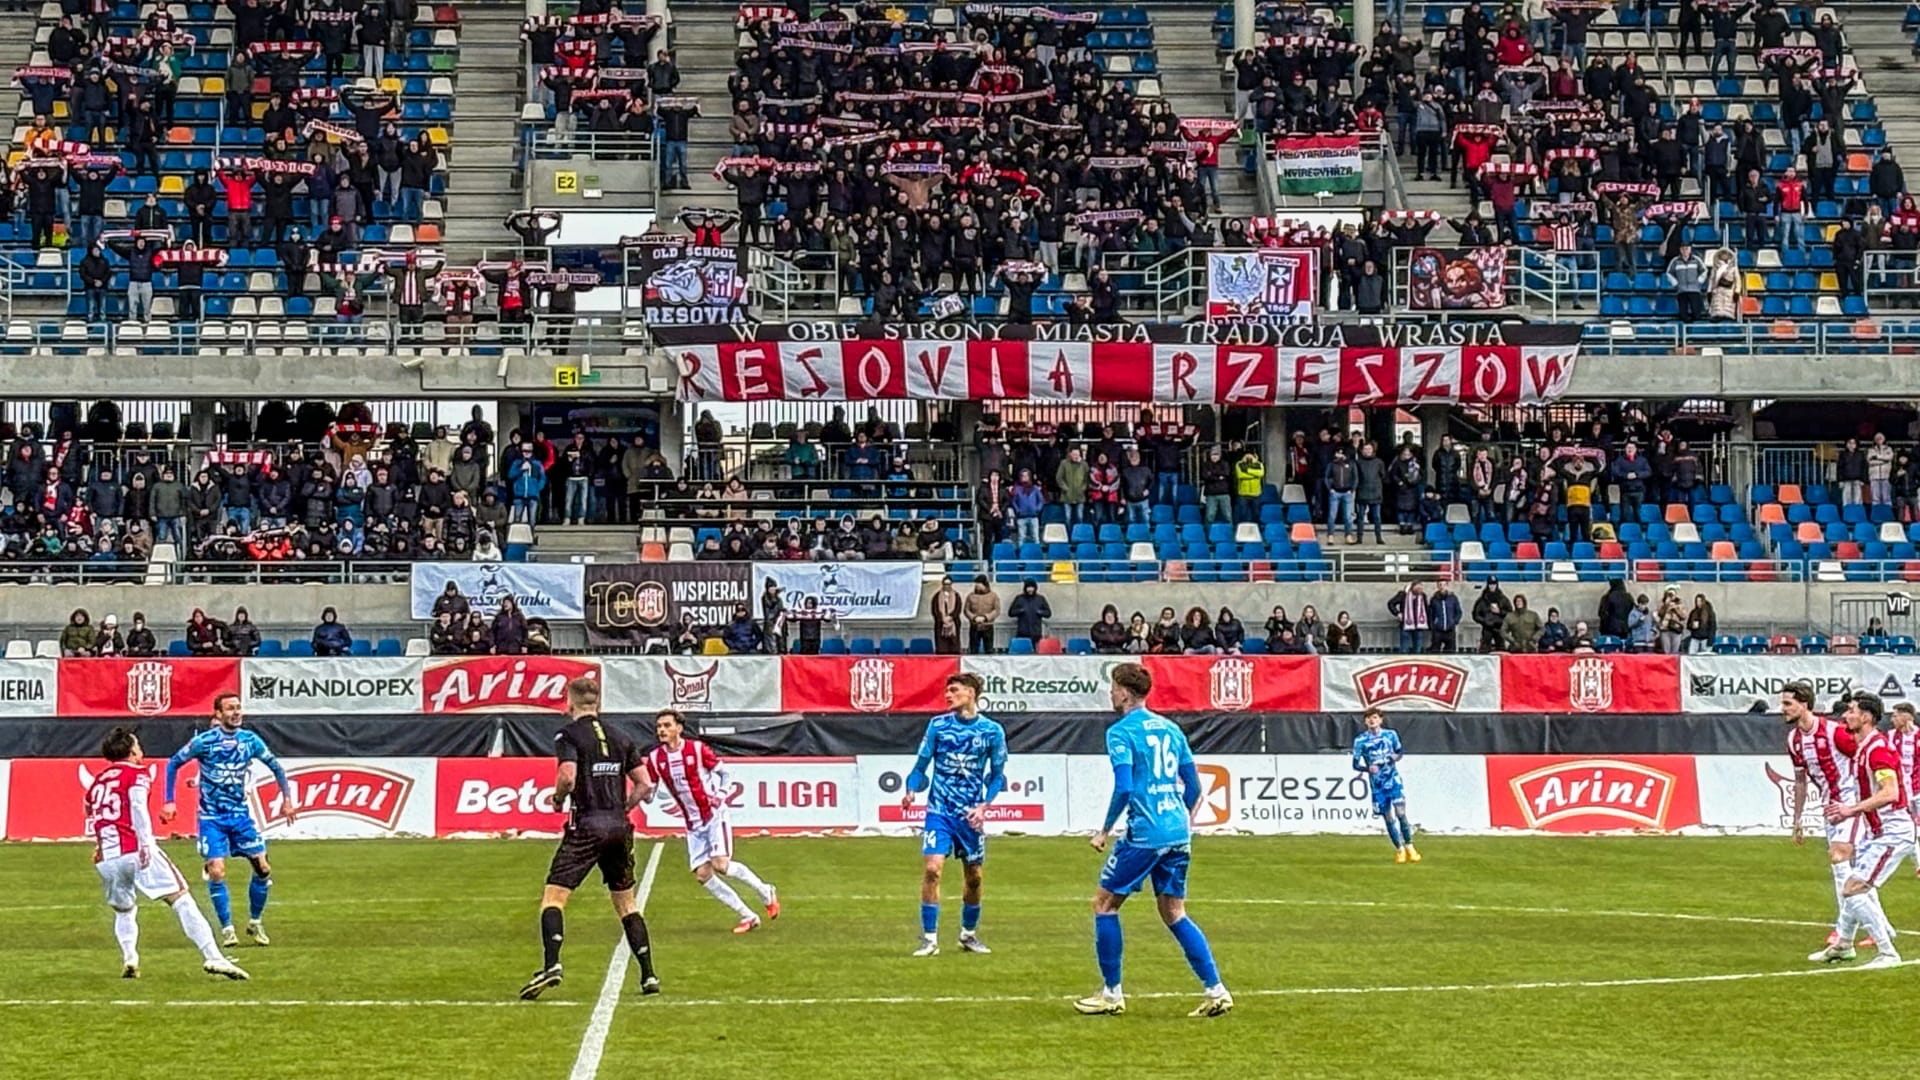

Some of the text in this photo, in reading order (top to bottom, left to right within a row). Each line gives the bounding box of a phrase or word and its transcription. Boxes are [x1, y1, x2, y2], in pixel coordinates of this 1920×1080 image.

[557, 176, 575, 189] E2
[652, 247, 737, 260] OLD SCHOOL
[645, 306, 747, 324] RESOVIA
[730, 322, 1507, 348] W OBIE STRONY MIASTA TRADYCJA WRASTA
[559, 371, 576, 384] E1
[678, 346, 1075, 399] RESOVIA
[672, 581, 748, 601] WSPIERAJ
[786, 588, 891, 608] Rszowianka
[680, 604, 736, 625] RESOVI
[1887, 597, 1910, 612] VIP
[279, 678, 415, 697] HANDLOPEX
[1012, 675, 1099, 694] Rzeszów
[1369, 666, 1454, 700] Arini
[1720, 677, 1853, 695] HANDPEX
[1145, 734, 1178, 779] 76
[268, 773, 394, 818] Arini
[724, 781, 838, 808] 2 LIGA
[1239, 771, 1369, 801] rzeszó
[1534, 770, 1656, 816] Arini
[983, 806, 1023, 819] online
[1240, 803, 1304, 820] stolica
